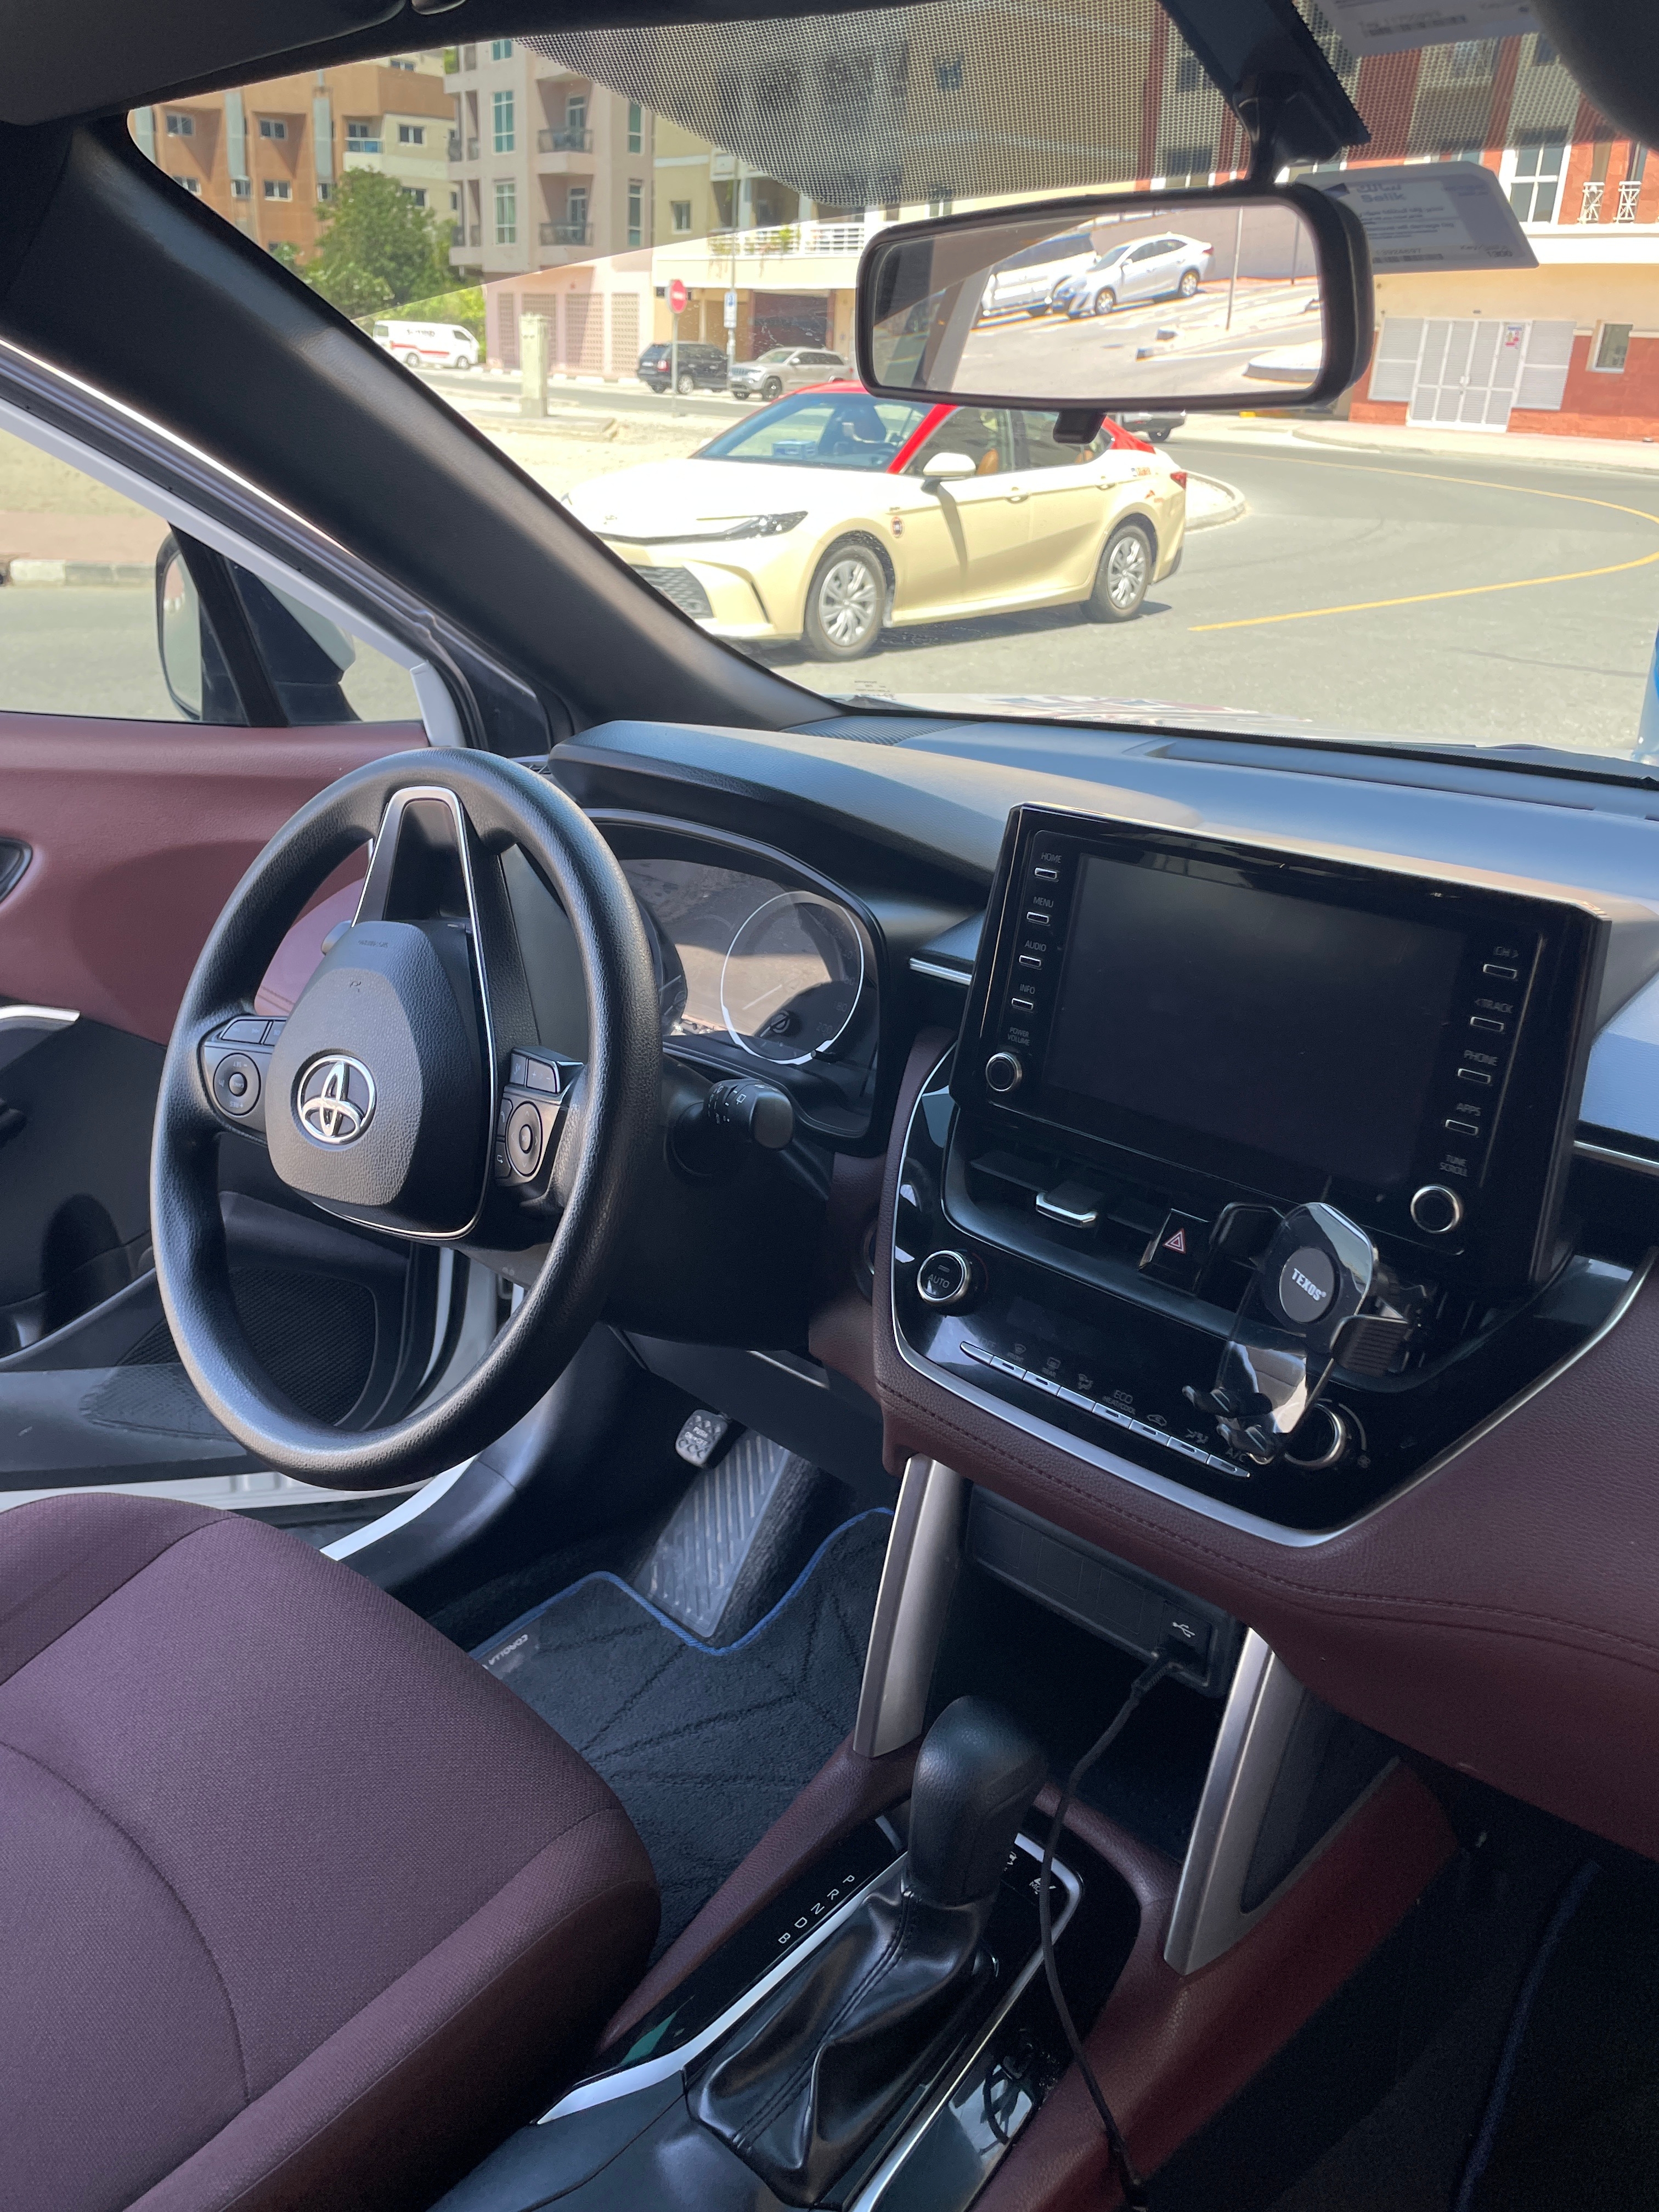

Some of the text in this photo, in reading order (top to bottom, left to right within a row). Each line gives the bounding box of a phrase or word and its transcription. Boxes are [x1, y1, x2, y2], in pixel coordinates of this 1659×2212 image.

[1361, 193, 1406, 202] Salik
[1041, 852, 1062, 864] HOME
[1033, 896, 1054, 908] MENU
[1024, 940, 1047, 952] AUDIO
[1019, 983, 1035, 995] INFO
[1009, 1026, 1029, 1038] POWER
[1007, 1033, 1030, 1046] VOLUME
[1464, 1049, 1499, 1066] PHONE
[1456, 1103, 1482, 1116] APPS
[928, 1274, 951, 1288] AUTO
[1113, 1390, 1133, 1404] ECO
[693, 1426, 708, 1438] PUSH
[488, 1634, 528, 1665] COROLLA
[842, 1875, 855, 1883] P
[827, 1889, 840, 1900] R
[810, 1903, 825, 1915] N
[794, 1917, 808, 1928] D
[778, 1932, 791, 1944] B
